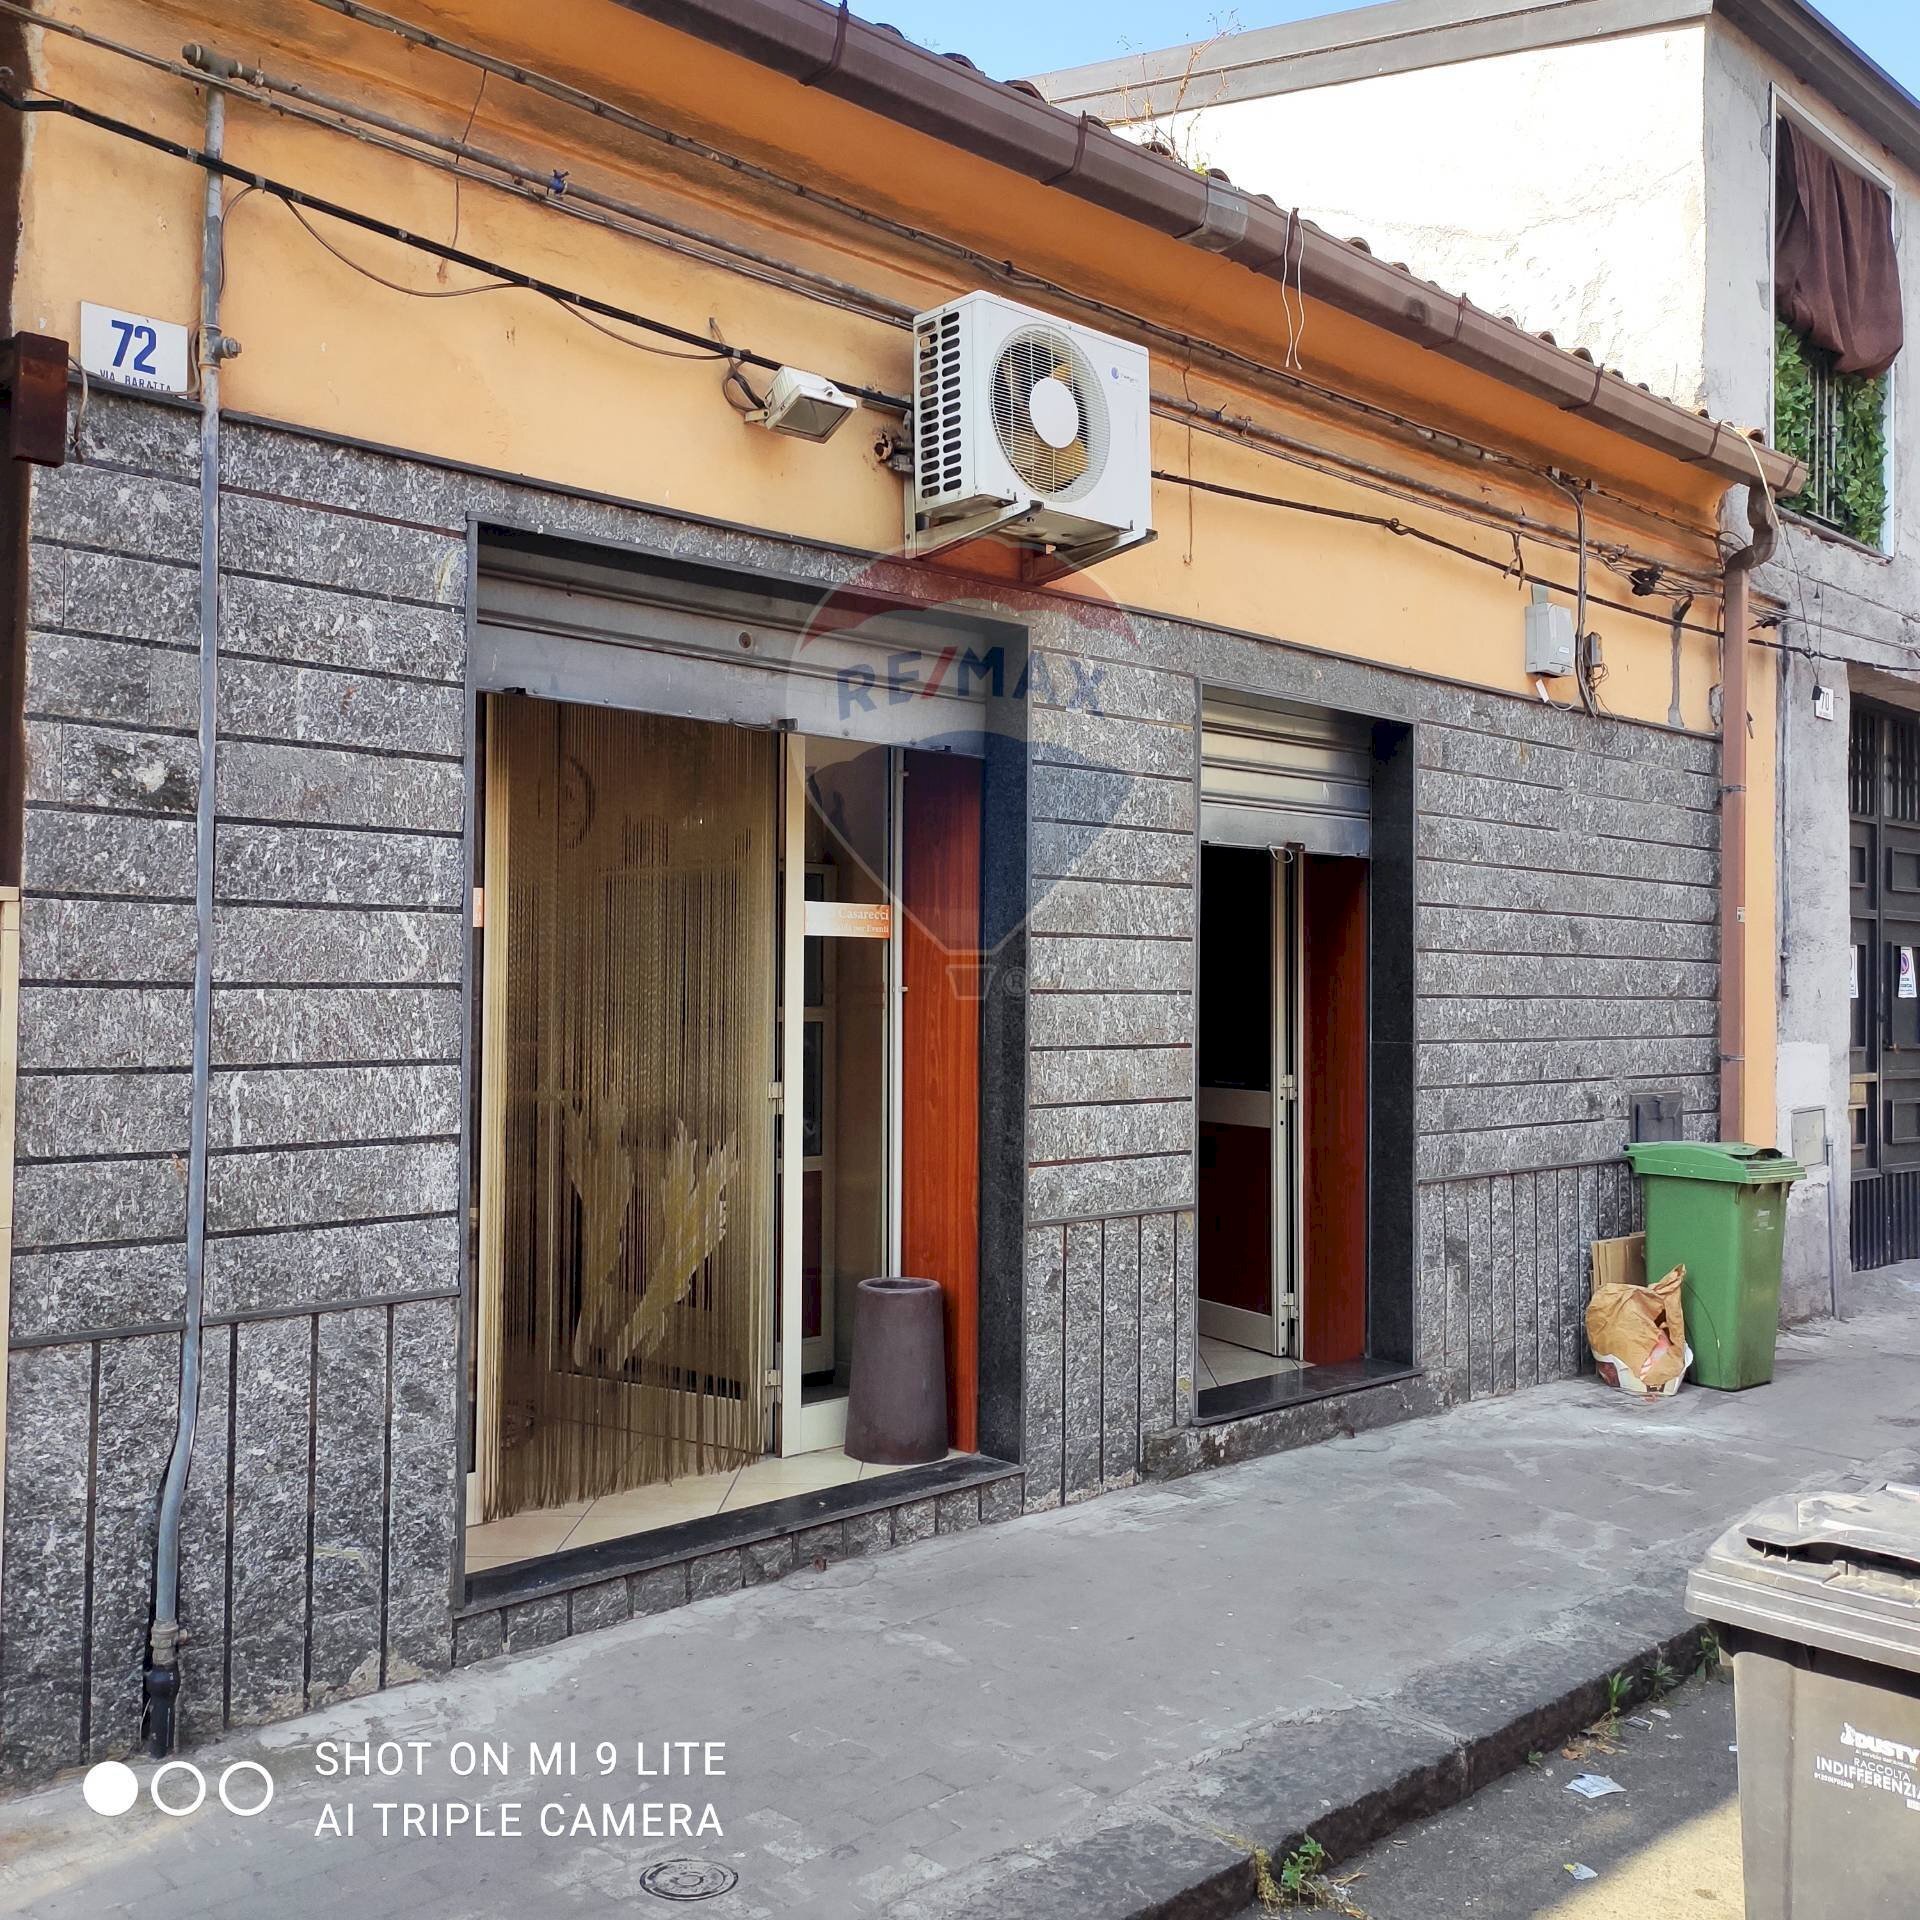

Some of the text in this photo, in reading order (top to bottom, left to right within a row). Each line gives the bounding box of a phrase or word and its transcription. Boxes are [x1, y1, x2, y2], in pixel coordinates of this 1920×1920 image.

[110, 319, 157, 375] 72
[99, 369, 116, 381] VIA
[1853, 1757, 1911, 1782] RACCOLTA
